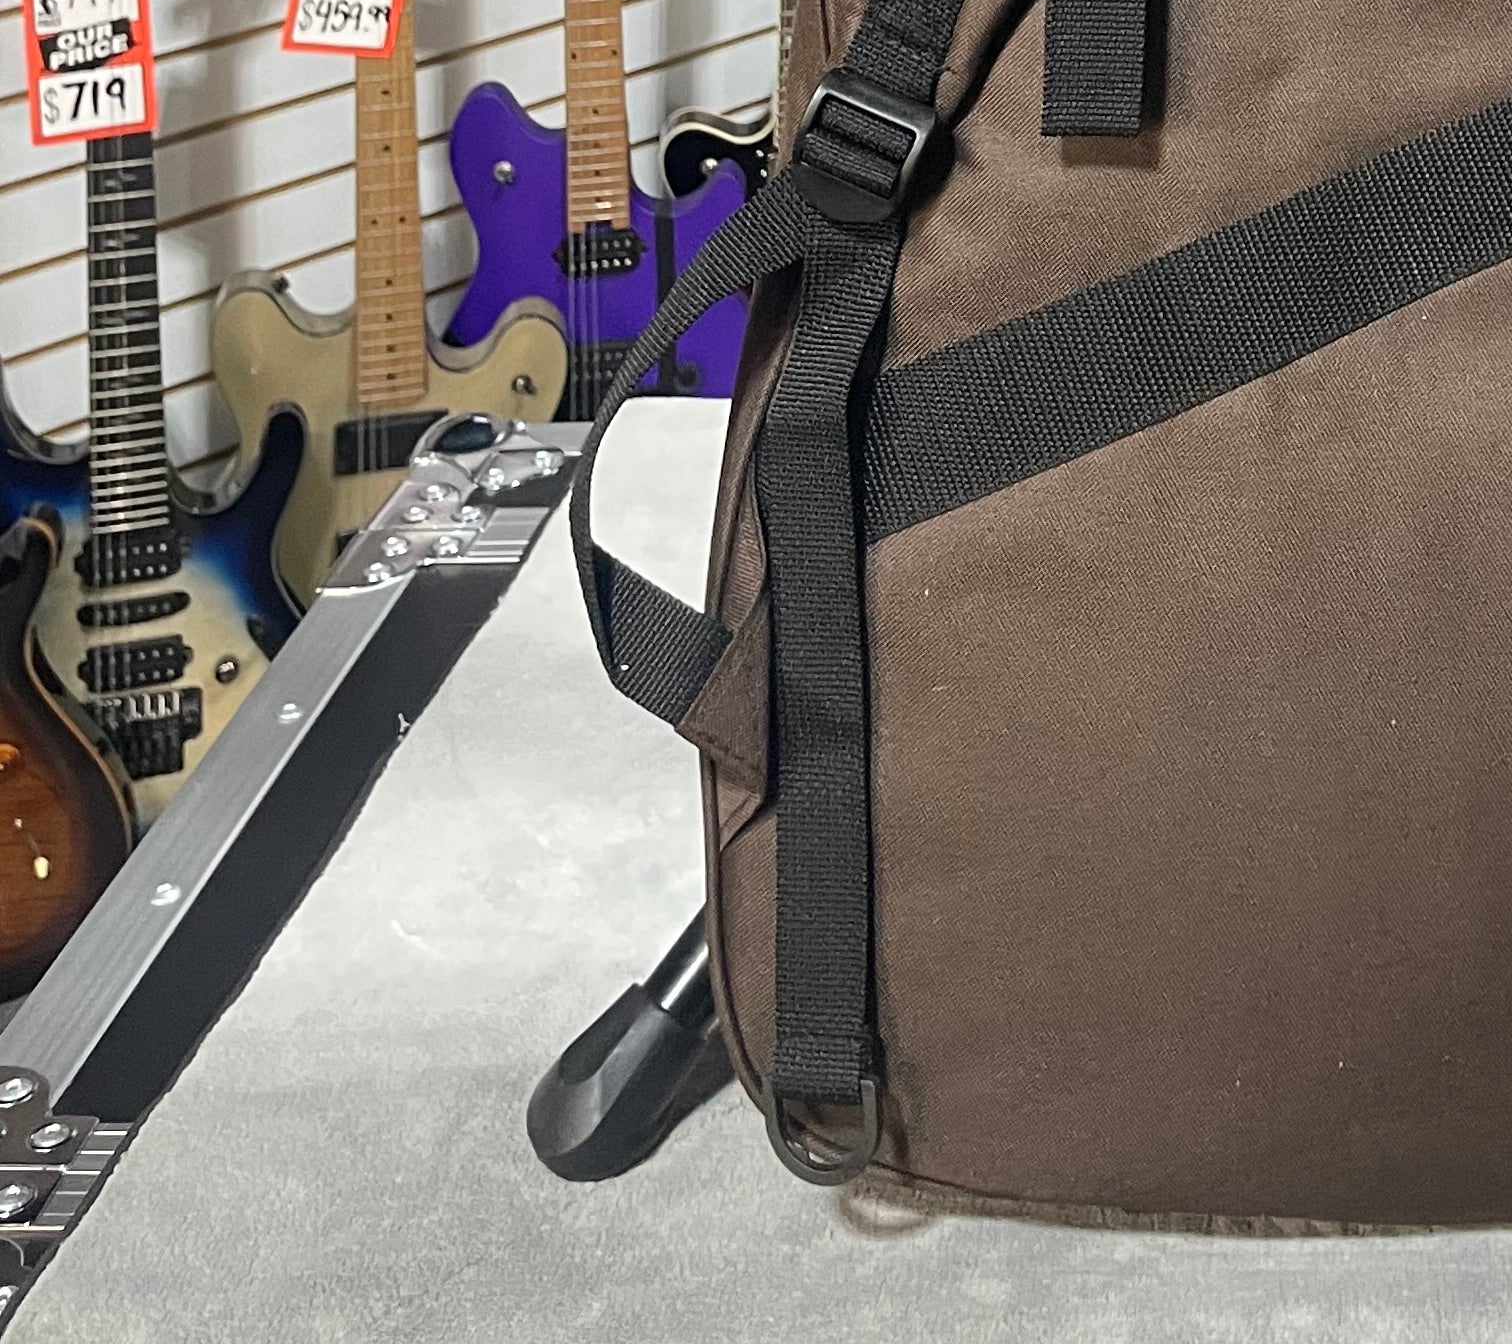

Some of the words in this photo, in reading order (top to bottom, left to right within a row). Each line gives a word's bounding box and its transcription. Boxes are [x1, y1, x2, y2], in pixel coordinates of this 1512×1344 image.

[49, 32, 129, 71] PRICE
[56, 23, 114, 50] OUR
[43, 76, 127, 124] $719
